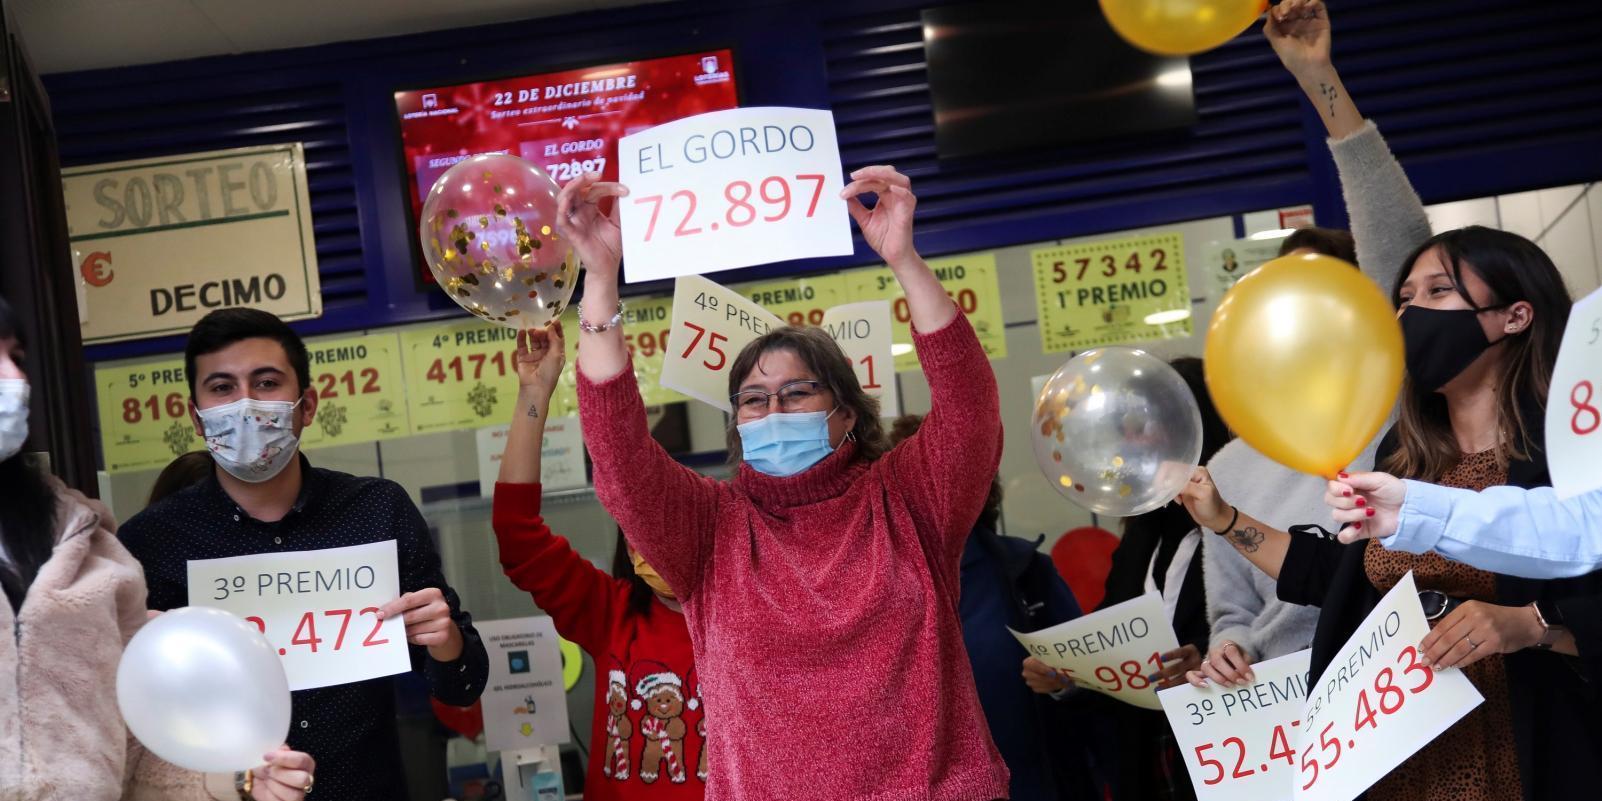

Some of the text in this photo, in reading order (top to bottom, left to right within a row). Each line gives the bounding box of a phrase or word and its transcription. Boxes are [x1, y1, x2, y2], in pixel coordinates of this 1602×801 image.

[494, 75, 637, 106] 22 DE DICIEMBRE
[543, 138, 605, 157] EL GORDO
[639, 125, 815, 174] EL GORDO
[93, 161, 278, 230] SORTEO
[634, 174, 826, 242] 72.897
[80, 251, 115, 288] €
[150, 273, 286, 316] DECIMO
[694, 291, 719, 311] 4º
[1078, 278, 1167, 306] PREMIO
[455, 327, 518, 347] PREMIO
[128, 373, 146, 389] 5º
[213, 565, 375, 601] 3º PREMIO
[246, 606, 390, 656] .472
[1053, 616, 1149, 659] PREMIO
[1305, 610, 1400, 733] 5º PREMIO
[1186, 699, 1216, 726] 3º
[1301, 645, 1434, 791] 55.483
